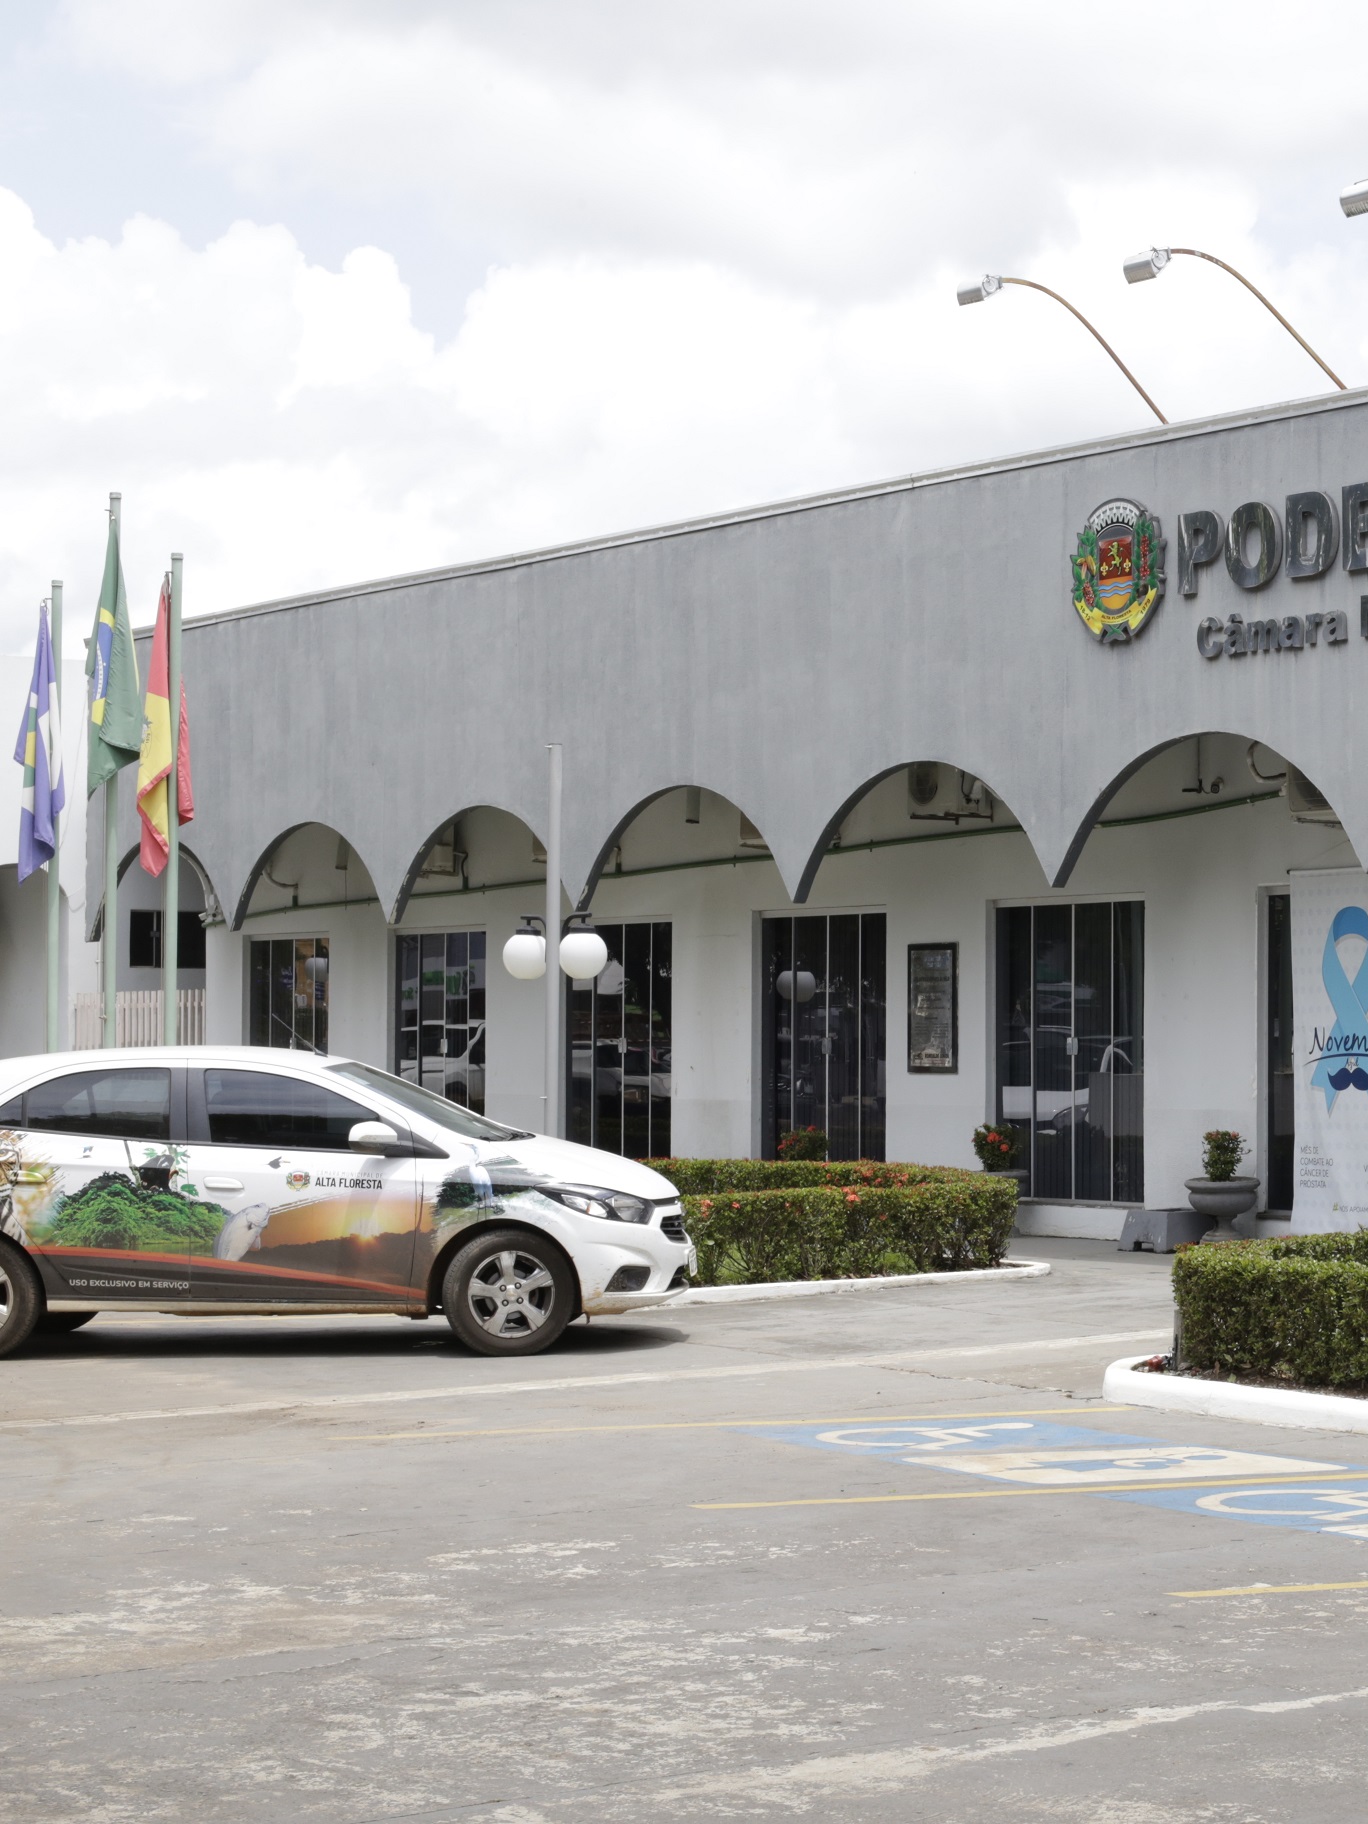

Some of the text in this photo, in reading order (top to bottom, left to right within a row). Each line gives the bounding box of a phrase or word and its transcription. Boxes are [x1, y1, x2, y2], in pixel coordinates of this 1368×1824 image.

[1197, 609, 1348, 660] Câmara
[1345, 1057, 1359, 1070] Azul
[1300, 1145, 1319, 1155] MÊS DE
[1300, 1157, 1334, 1167] COMBATE AO
[1300, 1168, 1329, 1178] CÂNCER DE
[315, 1176, 383, 1190] ALTA FLORESTA
[69, 1278, 189, 1290] USO EXCLUSIVO EM SERVIÇO
